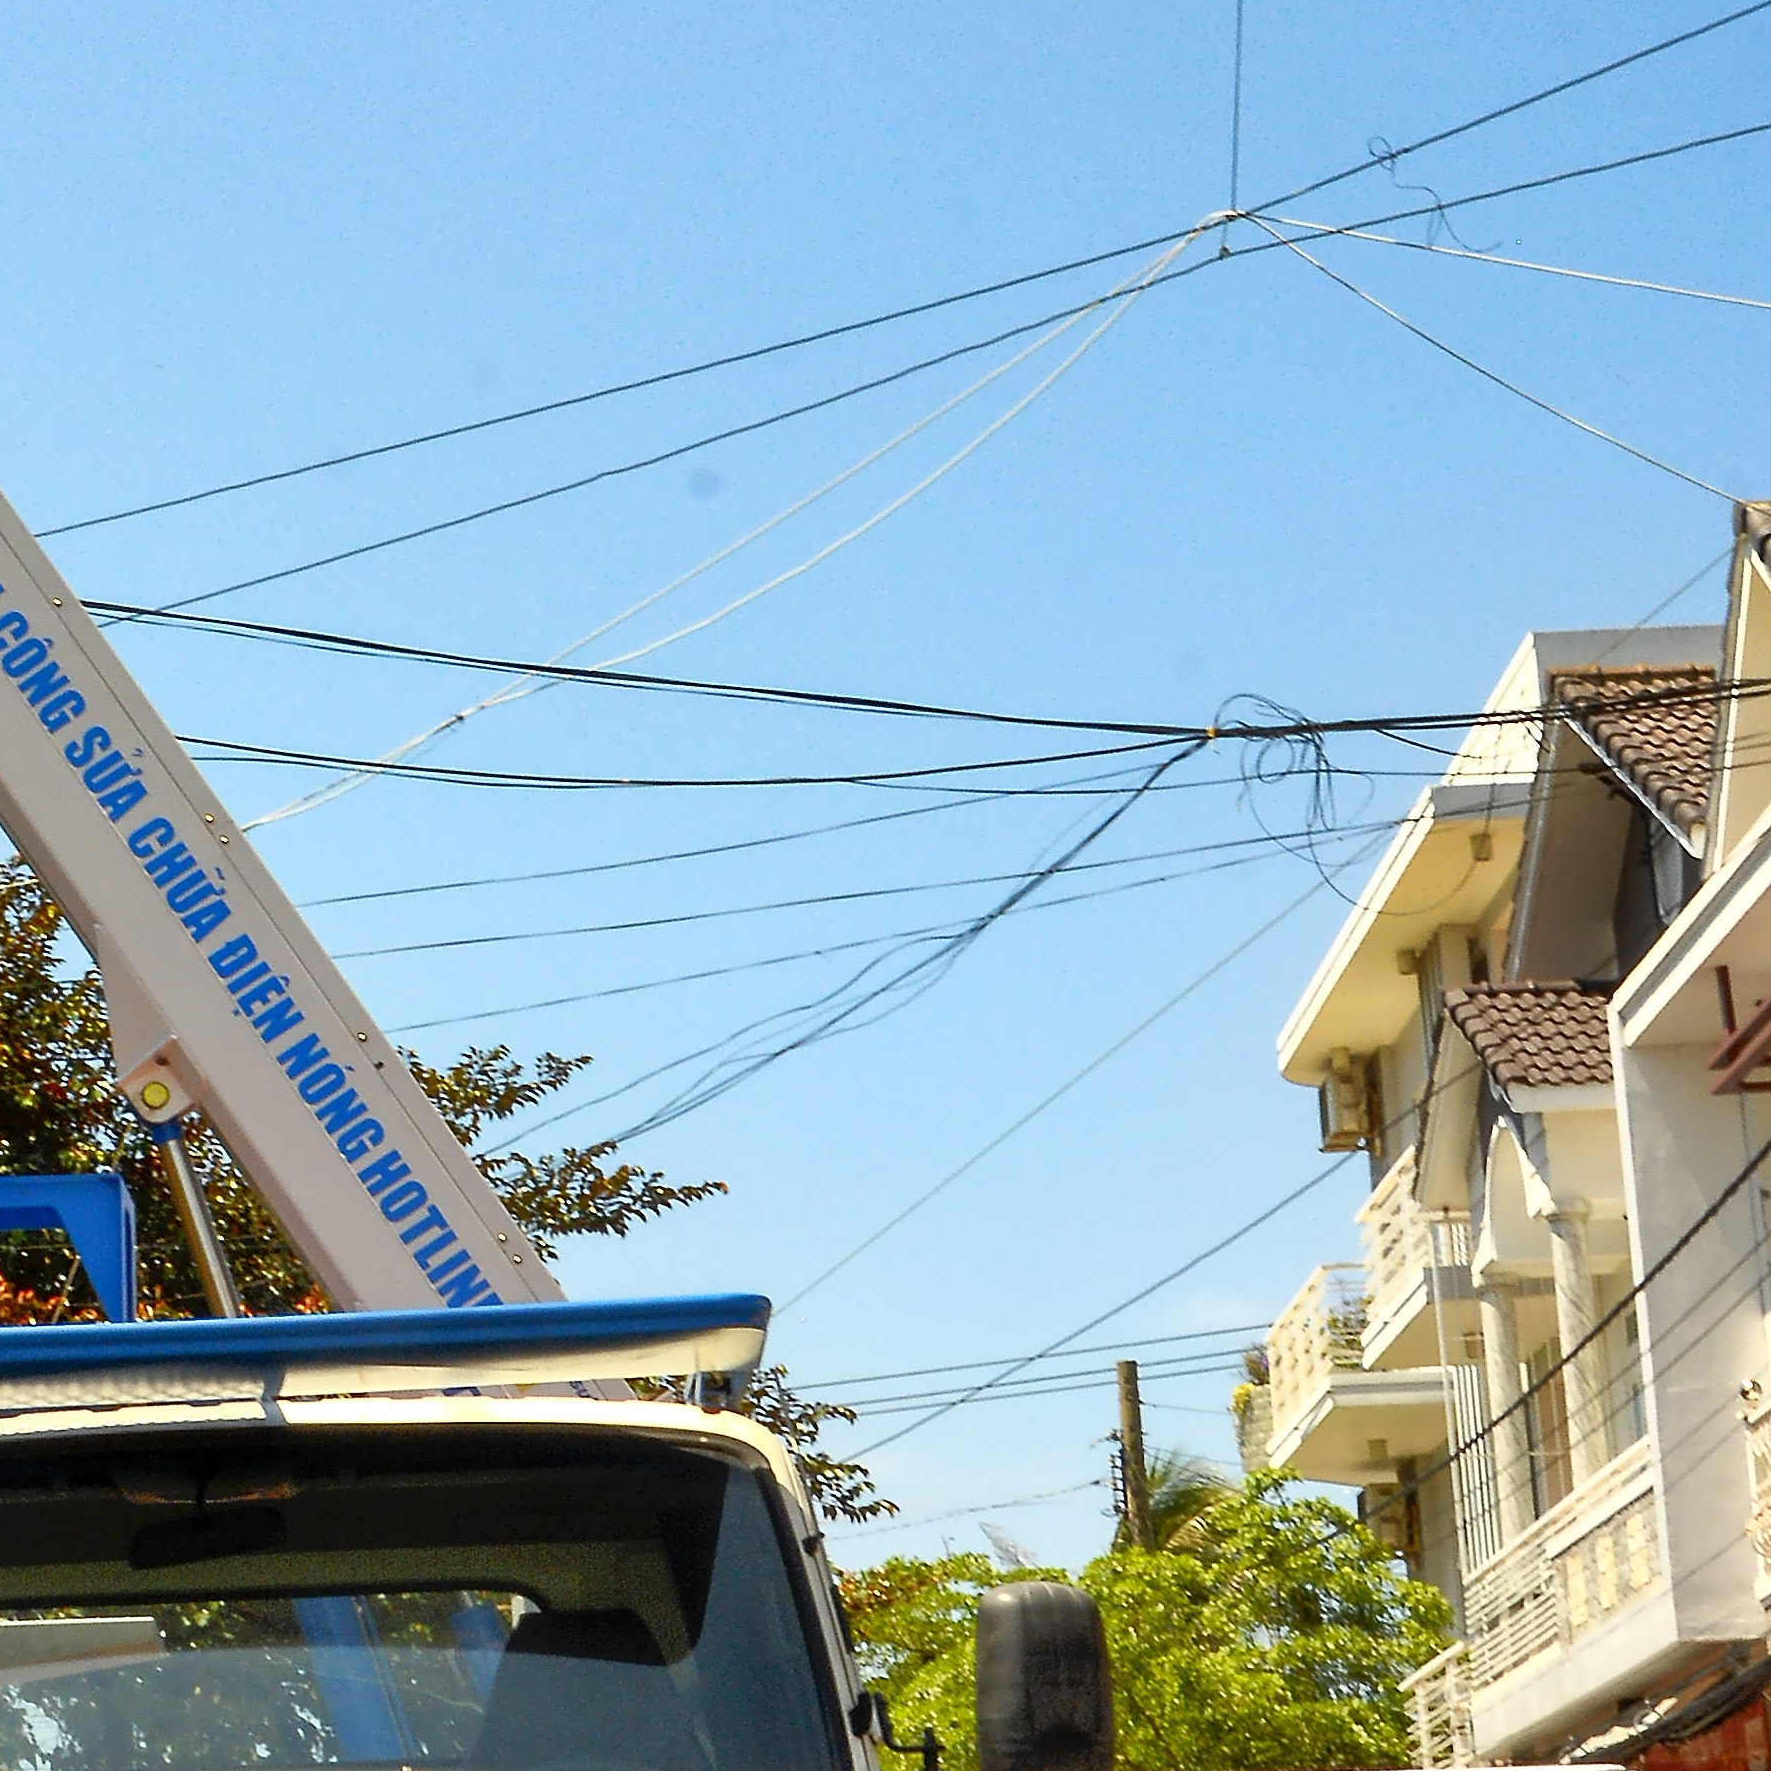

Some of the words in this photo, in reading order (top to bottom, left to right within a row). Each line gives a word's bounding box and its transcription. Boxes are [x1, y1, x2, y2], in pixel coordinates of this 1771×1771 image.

[64, 725, 149, 822] SỬA
[128, 817, 231, 943] CHỮA
[277, 1033, 385, 1163] NÓNG
